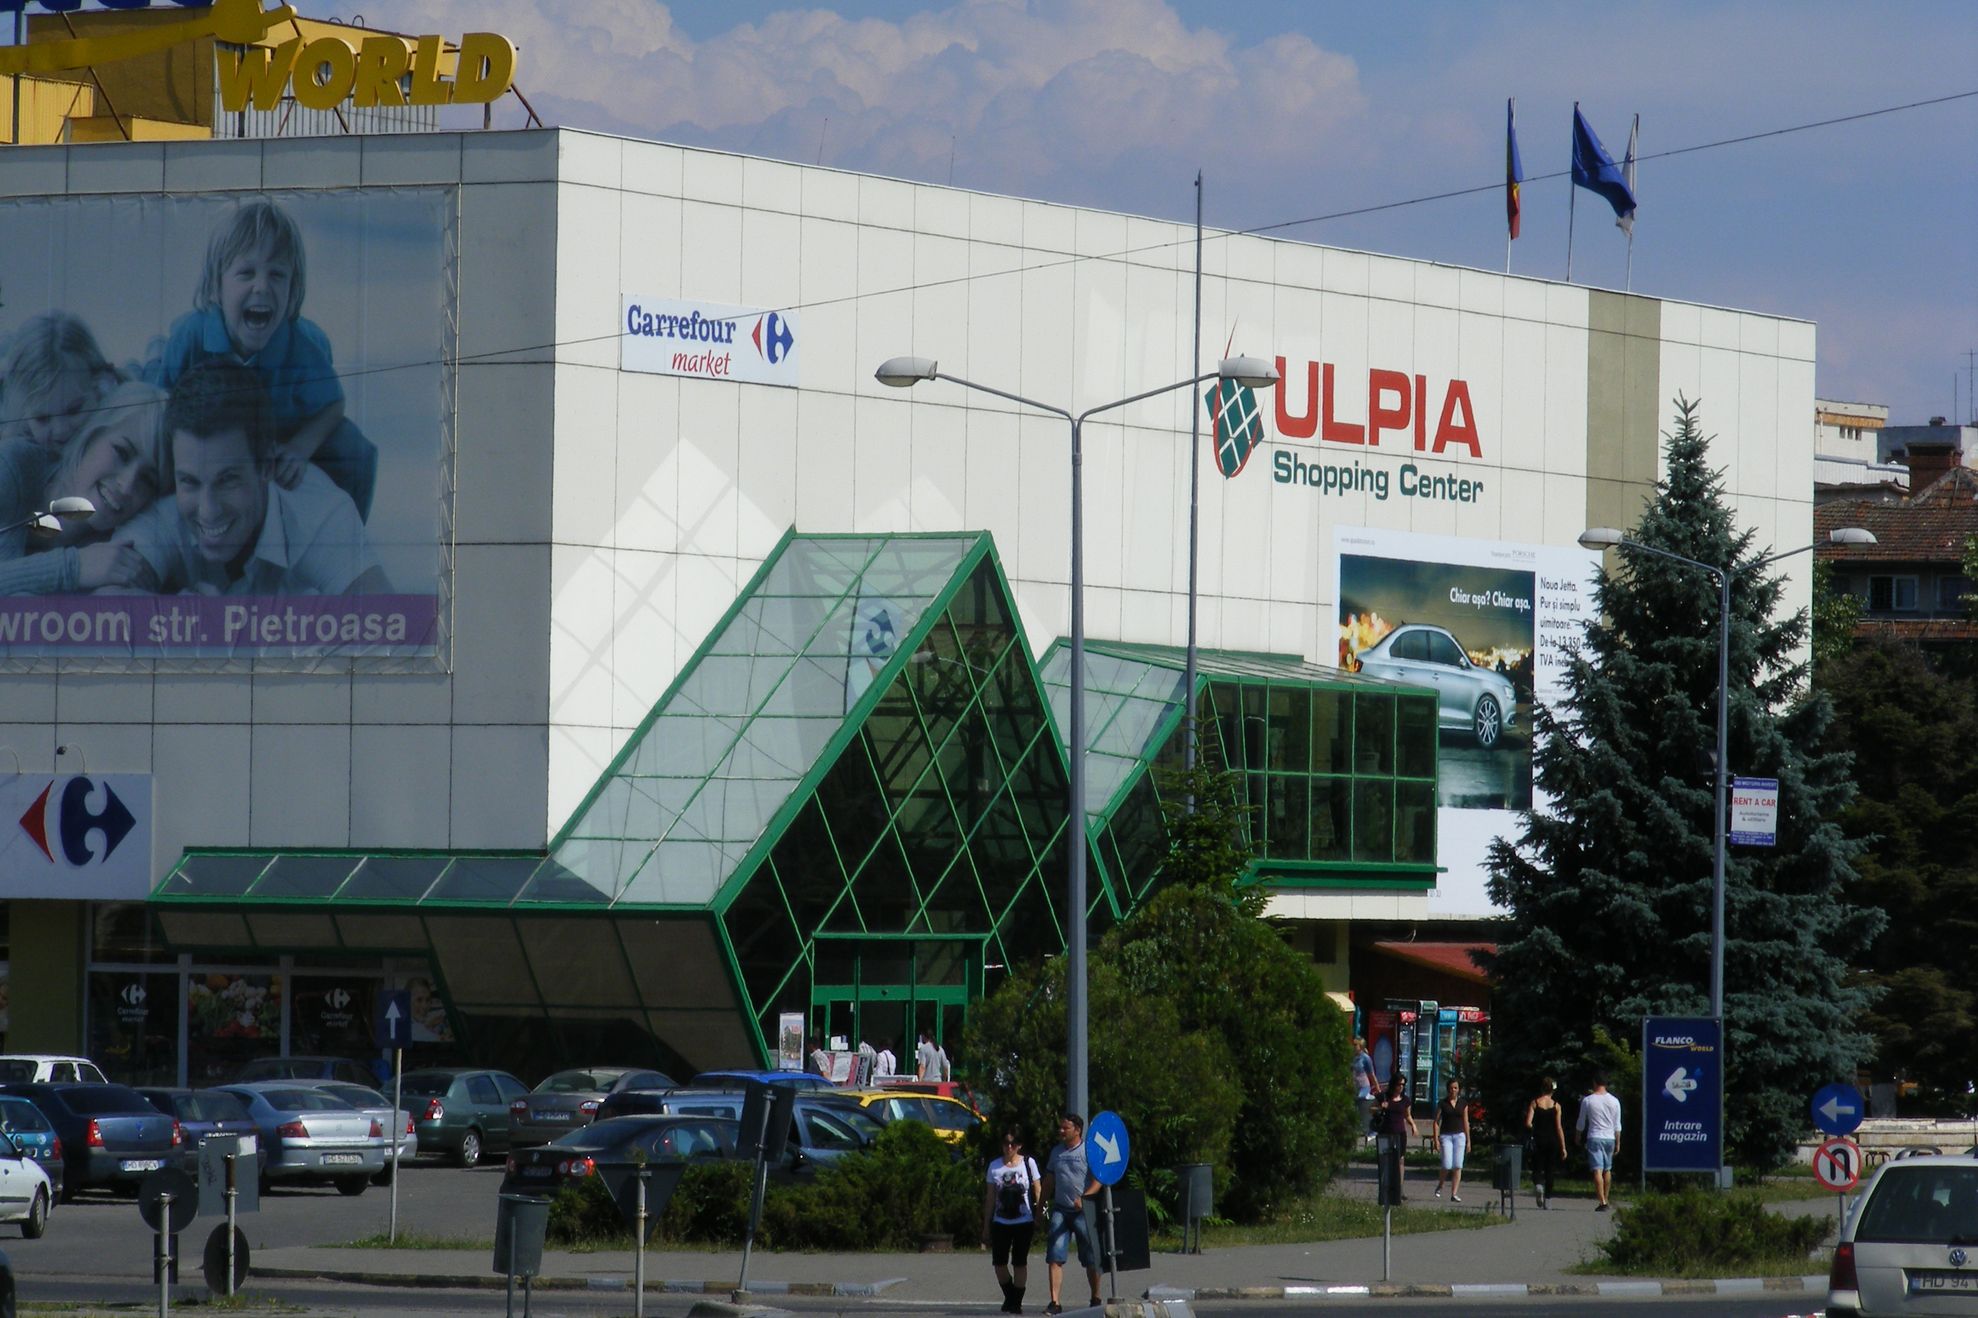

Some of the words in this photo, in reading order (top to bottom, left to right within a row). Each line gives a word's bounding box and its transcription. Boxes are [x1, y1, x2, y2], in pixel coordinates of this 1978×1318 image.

[216, 32, 517, 112] WORLD
[627, 304, 737, 345] Carrefour
[671, 349, 732, 378] market
[1274, 355, 1483, 459] ULPIA
[1273, 449, 1390, 501] Shopping
[1399, 463, 1484, 504] Center
[1560, 578, 1578, 592] Jetta.
[1449, 586, 1471, 604] Chiar
[1492, 590, 1514, 608] Chiar
[1540, 596, 1551, 609] Pur
[1560, 599, 1581, 614] simplu
[148, 607, 208, 643] str.
[224, 605, 407, 643] Pietroasa
[1540, 653, 1554, 667] TVA
[1733, 797, 1753, 806] RENT
[1755, 798, 1760, 806] A
[1762, 798, 1776, 808] CAR
[1655, 1036, 1694, 1045] FLANCO
[1690, 1045, 1715, 1053] WORLD
[1664, 1120, 1702, 1131] Intrare
[1659, 1131, 1708, 1144] magazin
[1922, 1275, 1945, 1288] HD
[1950, 1276, 1969, 1288] 94
